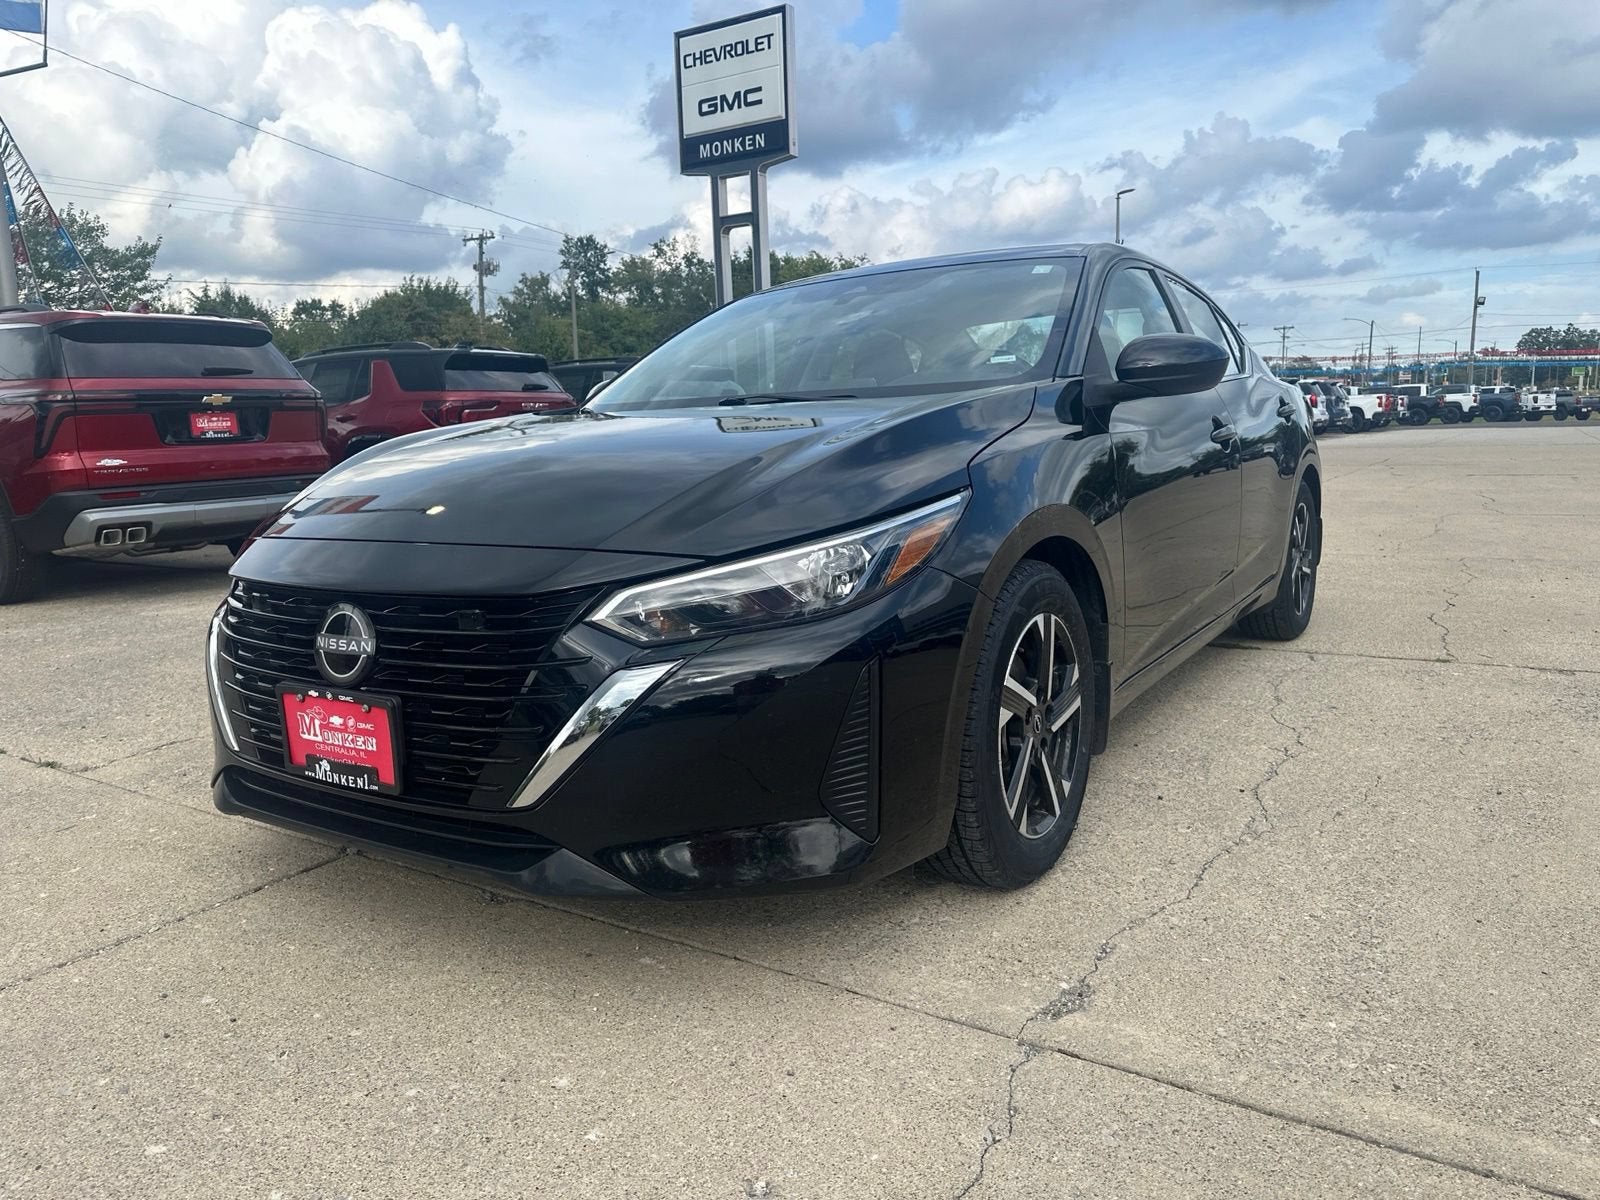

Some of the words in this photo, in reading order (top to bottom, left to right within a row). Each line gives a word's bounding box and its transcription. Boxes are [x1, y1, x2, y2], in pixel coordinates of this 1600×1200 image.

[683, 33, 774, 69] CHEVROLET
[698, 86, 763, 117] GMC
[699, 133, 765, 158] MONKEN
[317, 636, 371, 652] NISSAN
[297, 712, 377, 751] MONKEN
[357, 722, 375, 730] GMC
[360, 751, 368, 759] IL
